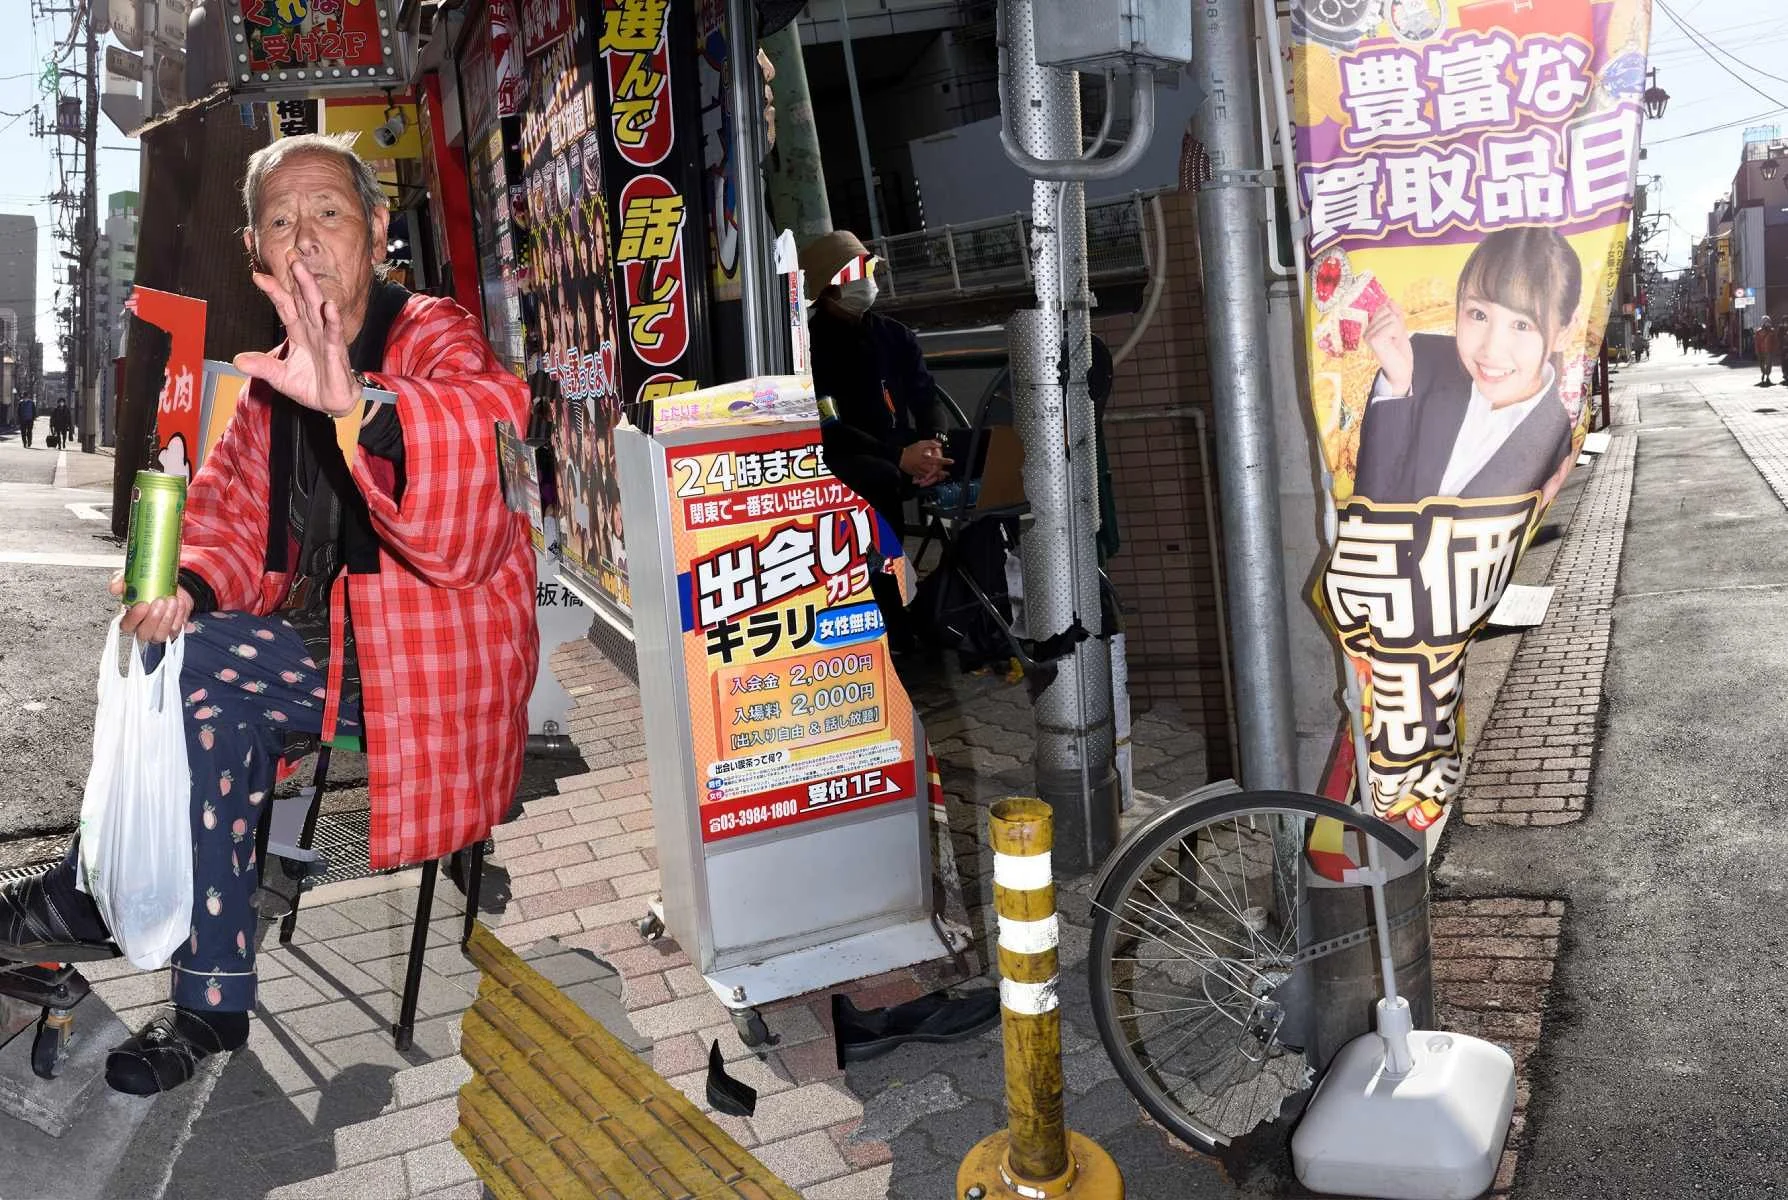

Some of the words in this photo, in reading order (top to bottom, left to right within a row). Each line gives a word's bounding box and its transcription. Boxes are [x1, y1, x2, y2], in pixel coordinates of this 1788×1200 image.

[262, 31, 367, 63] 受付2F
[1345, 37, 1589, 143] 豊富な
[1304, 108, 1637, 248] 買取品目
[617, 195, 684, 346] 話して
[698, 509, 872, 627] 出会い
[1325, 510, 1529, 638] 高価
[706, 603, 815, 664] キラリ
[730, 673, 780, 695] 入会金
[790, 654, 872, 686] 2,000円
[732, 703, 781, 725] 入場料
[791, 683, 874, 716] 2,000円
[720, 799, 798, 830] 03-3984-1800
[807, 770, 882, 806] 受付1F
